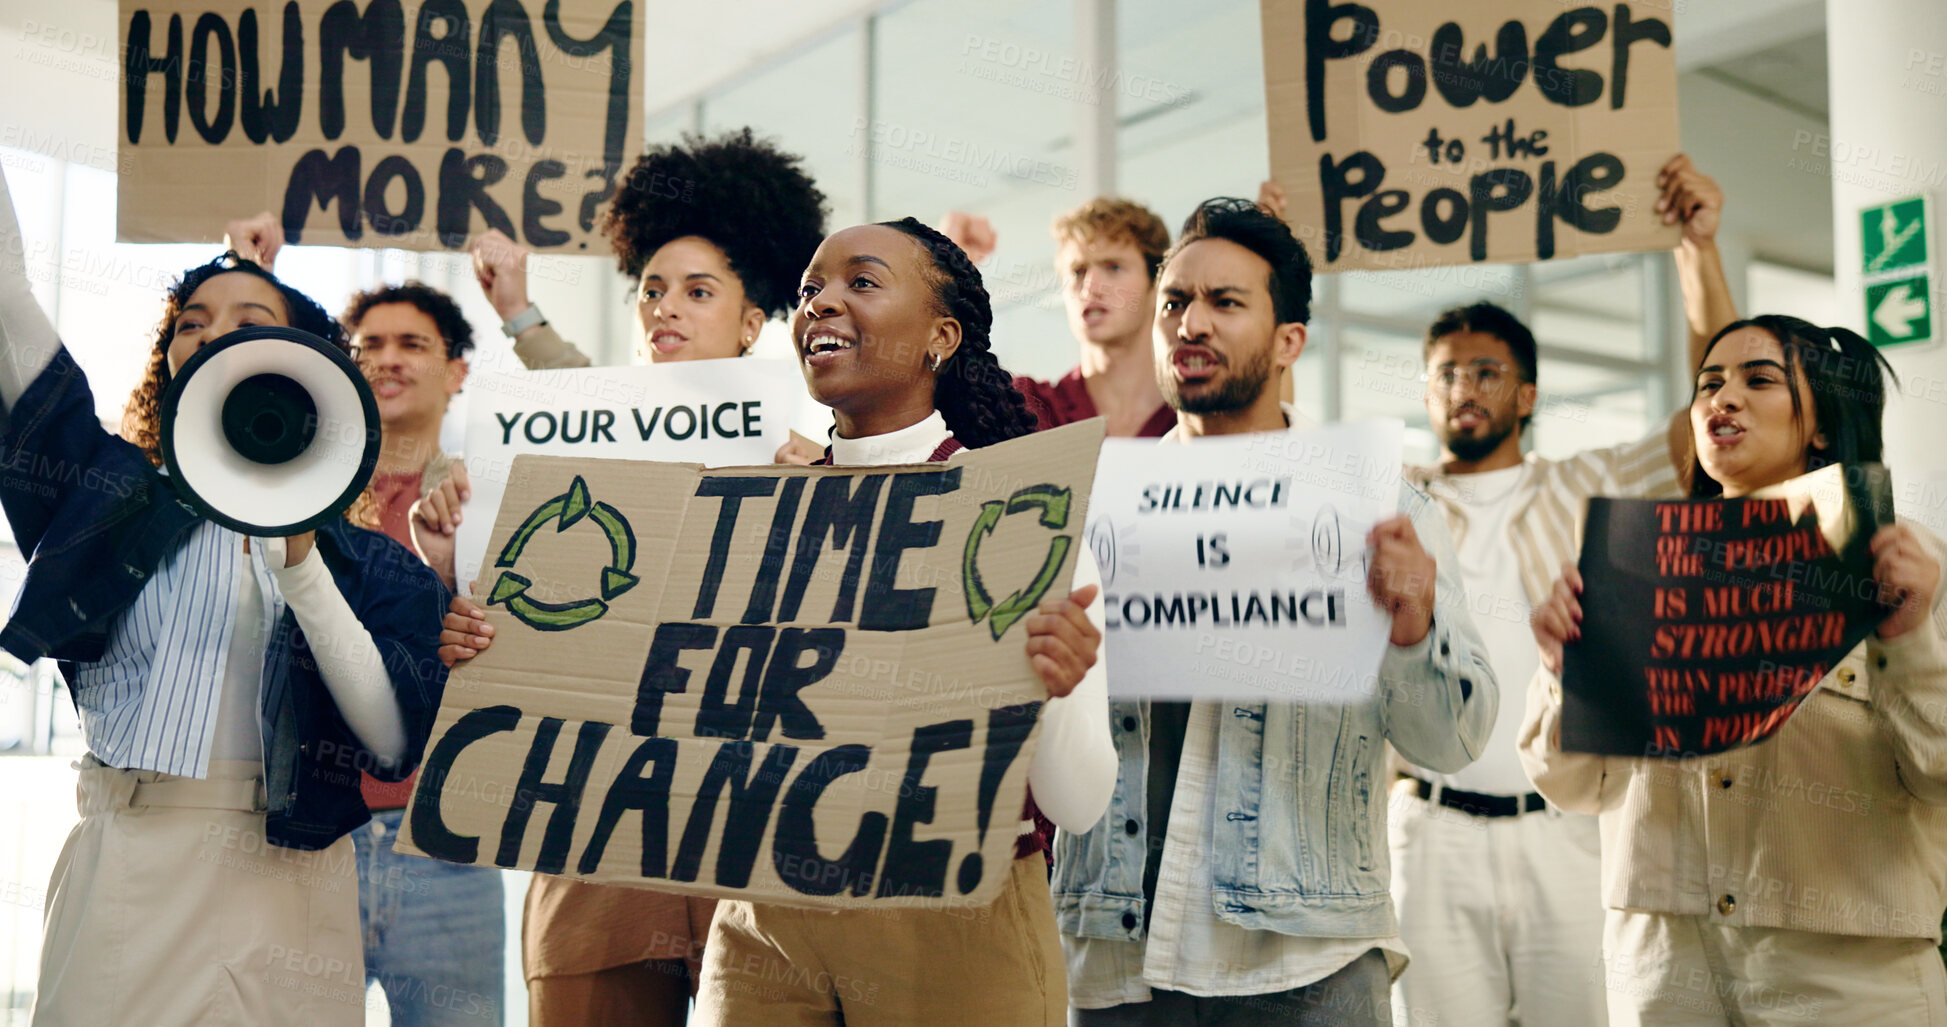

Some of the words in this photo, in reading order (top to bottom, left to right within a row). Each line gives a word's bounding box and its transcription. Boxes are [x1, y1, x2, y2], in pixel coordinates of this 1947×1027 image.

[1424, 127, 1464, 164] to
[1481, 118, 1549, 161] the
[495, 409, 617, 445] YOUR
[631, 400, 762, 441] VOICE
[1139, 479, 1291, 512] SILENCE
[1656, 502, 1723, 533] THE
[694, 467, 962, 631] TIME
[1197, 533, 1229, 567] IS
[1654, 587, 1687, 619] IS
[1704, 580, 1794, 619] MUCH
[1650, 611, 1846, 659] STRONGER
[631, 622, 847, 742] FOR
[1655, 725, 1681, 750] IN
[413, 702, 1042, 897] CHANGE!
